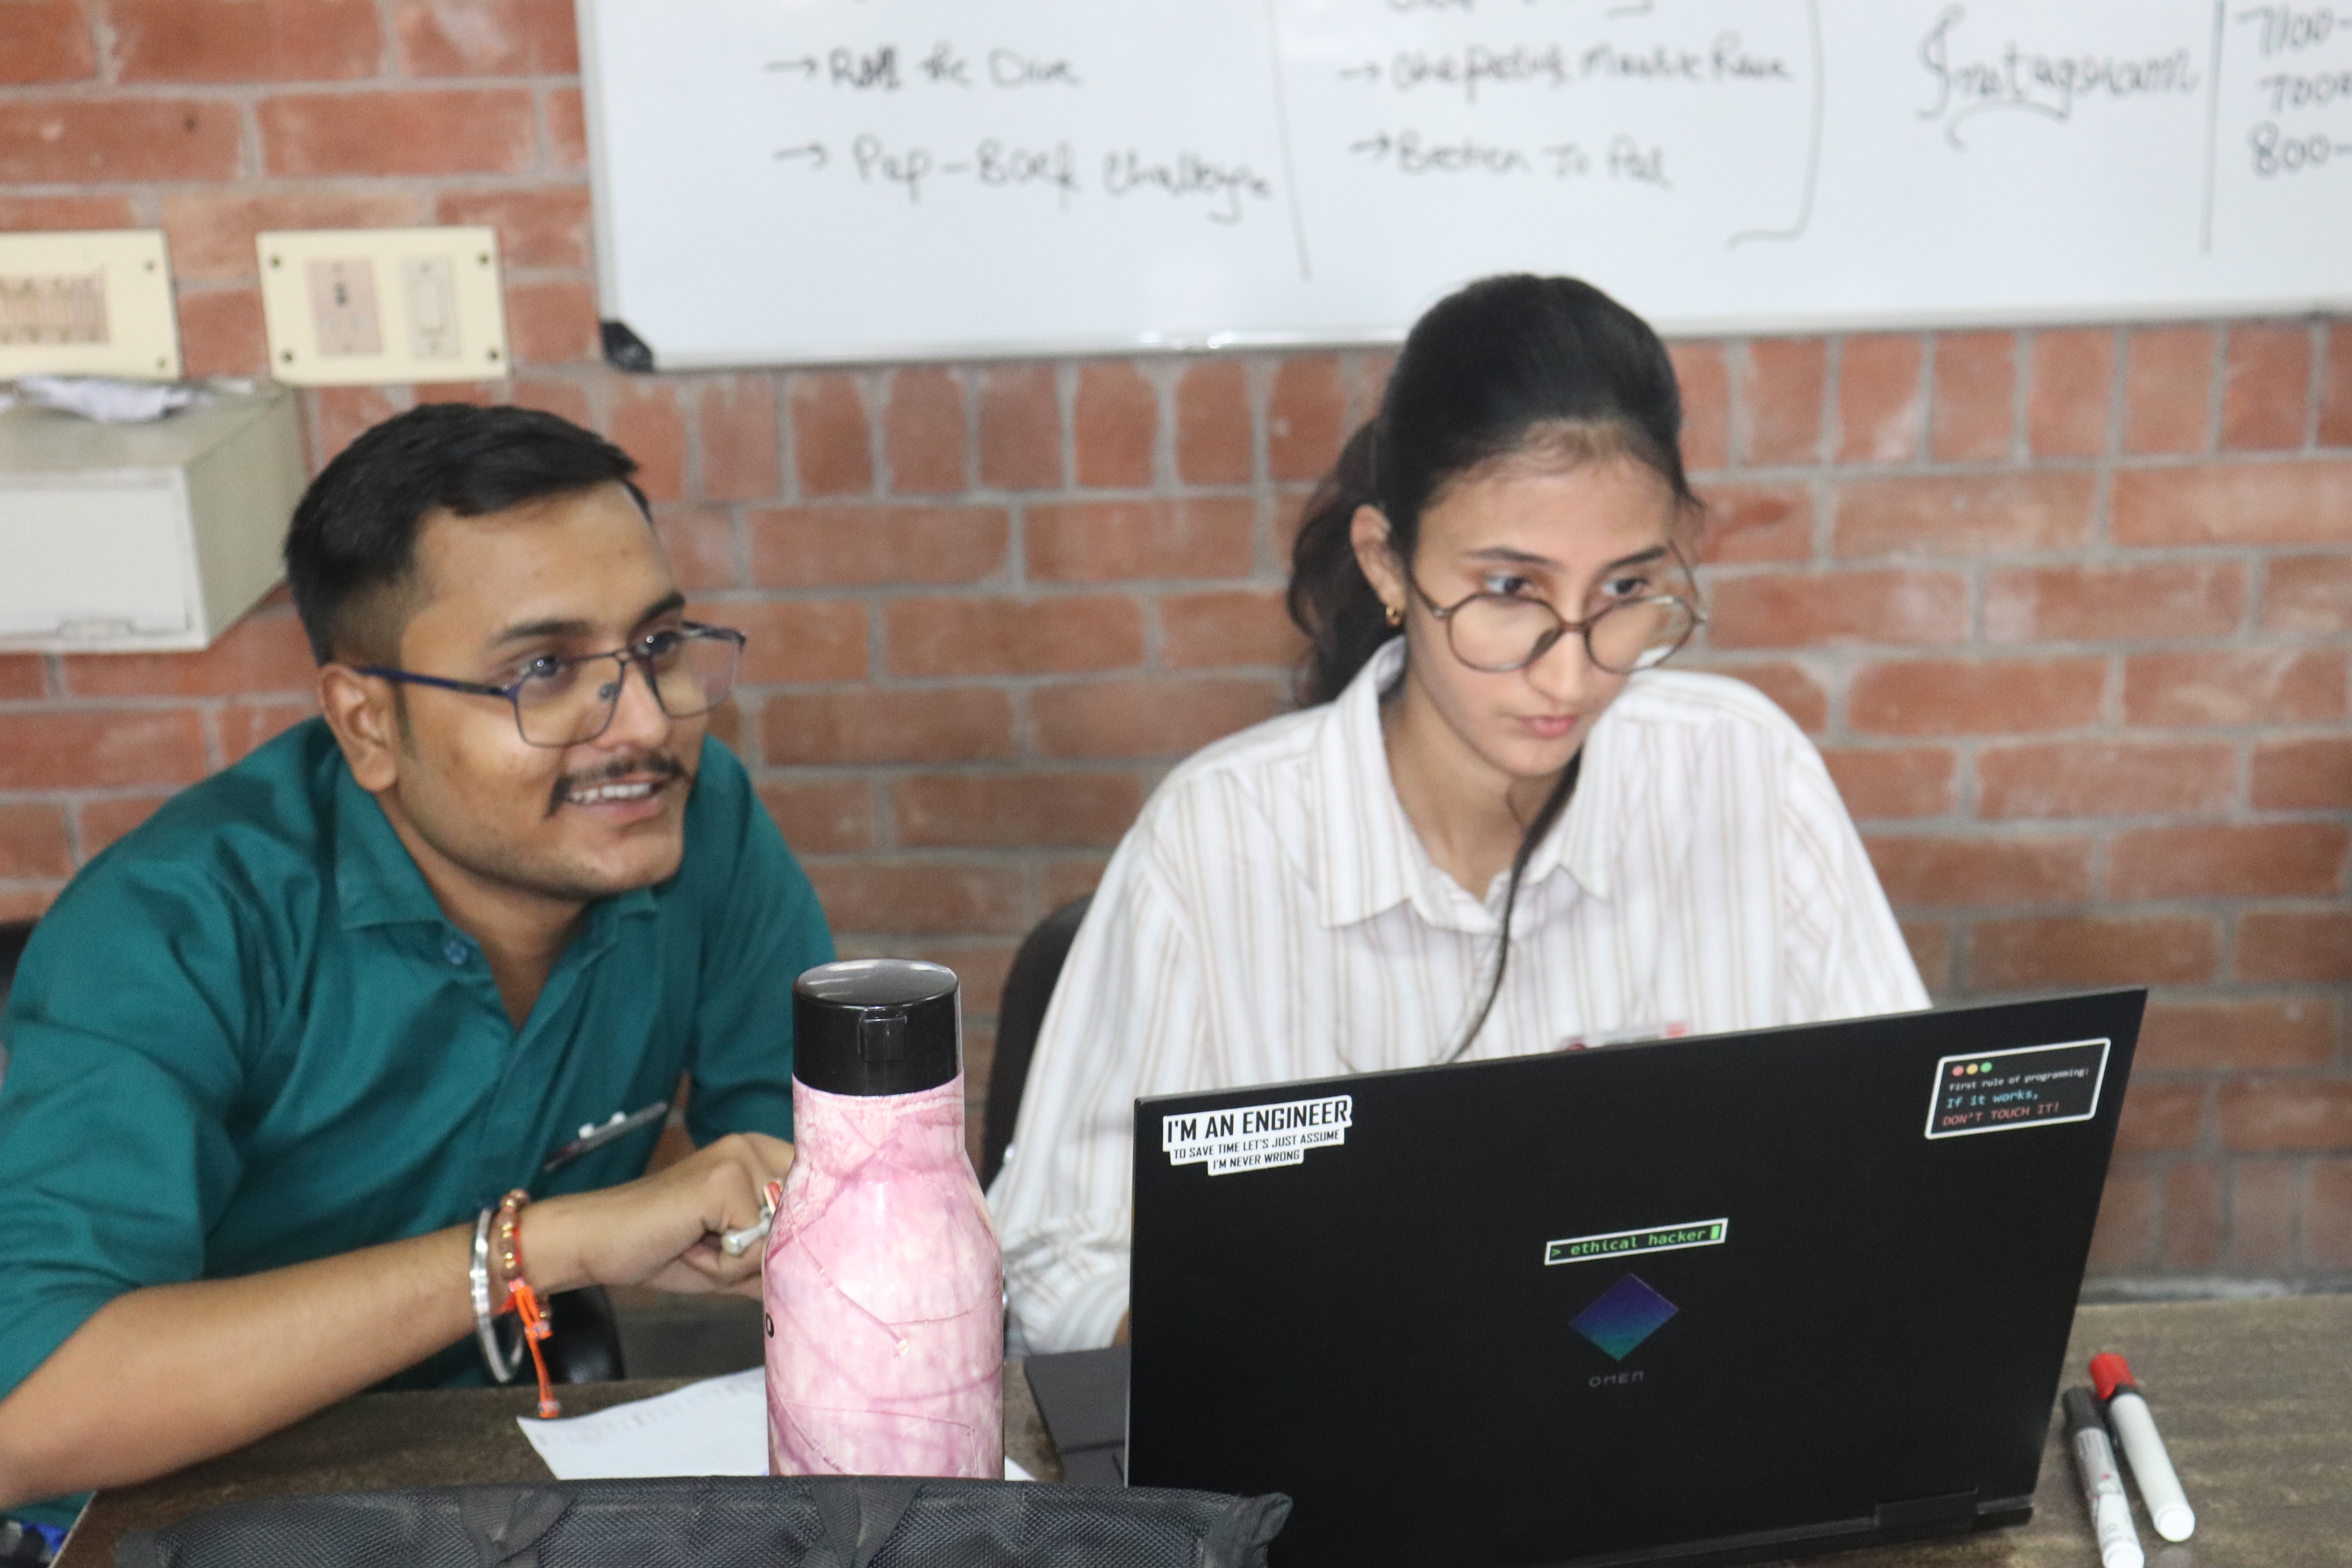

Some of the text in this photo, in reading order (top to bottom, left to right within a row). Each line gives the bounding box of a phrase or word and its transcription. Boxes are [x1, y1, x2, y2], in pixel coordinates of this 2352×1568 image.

[1949, 1068, 2089, 1091] First rule of programming:
[1947, 1090, 2038, 1109] If it works,
[1168, 1100, 1348, 1143] I'M AN ENGINEER
[1942, 1102, 2060, 1127] DON'T TOUCH IT!
[1174, 1129, 1340, 1159] TO SAVE TIME LET'S JUST ASSUME
[1213, 1150, 1300, 1169] I'M NEVER WRONG
[1570, 1235, 1637, 1256] ethical
[1648, 1229, 1706, 1246] hacker
[1589, 1370, 1644, 1388] OMEN
